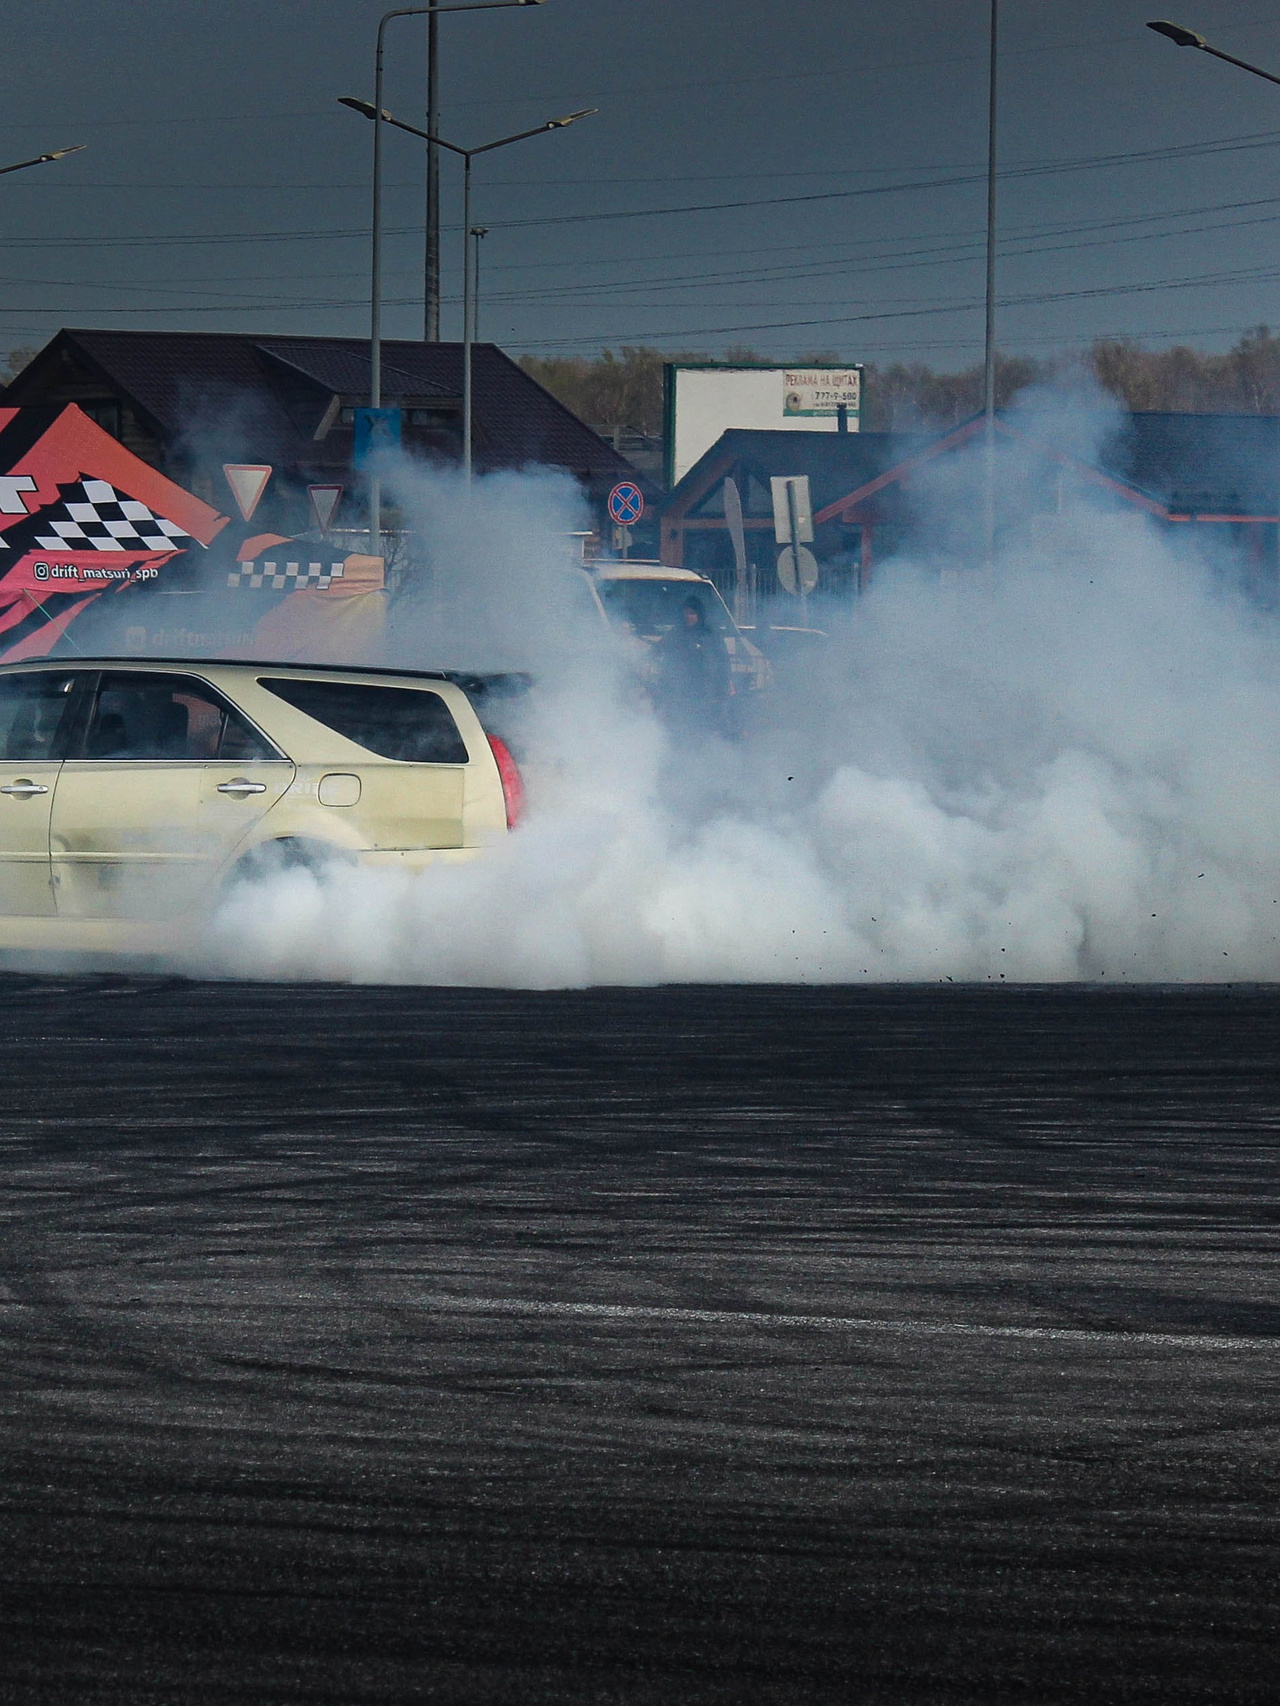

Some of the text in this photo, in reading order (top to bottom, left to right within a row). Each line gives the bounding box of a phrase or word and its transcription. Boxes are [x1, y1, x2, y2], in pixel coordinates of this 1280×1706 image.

[786, 373, 817, 386] РЕКЛАМА
[820, 374, 830, 386] НА
[51, 564, 158, 582] drift_matsuri_spb
